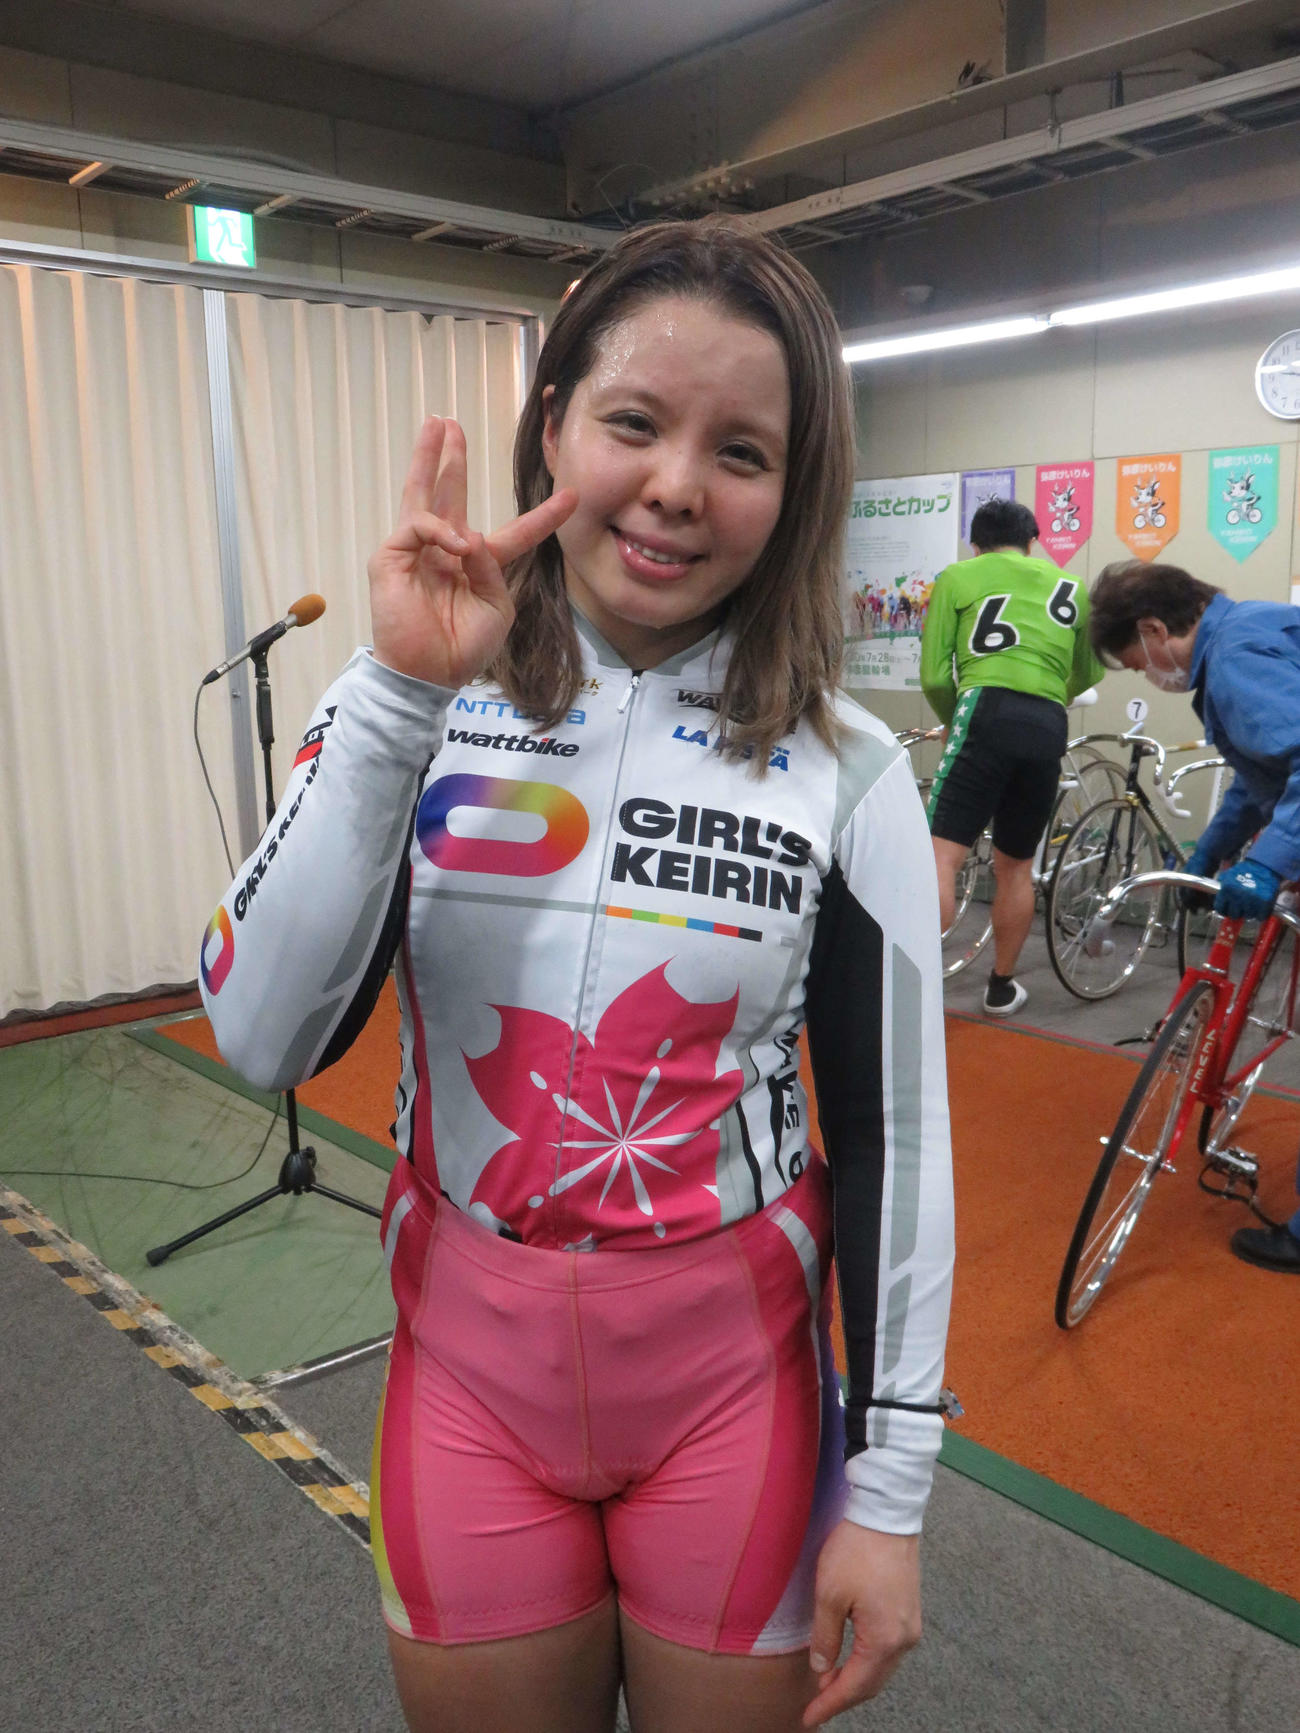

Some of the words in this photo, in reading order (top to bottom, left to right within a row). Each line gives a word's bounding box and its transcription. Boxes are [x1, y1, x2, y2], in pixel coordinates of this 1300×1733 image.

[968, 594, 1020, 656] 6
[1047, 577, 1079, 628] 6
[1133, 701, 1142, 719] 7
[447, 728, 580, 758] wattbike
[619, 797, 812, 866] GIRL'S
[610, 842, 803, 915] KEIRIN
[1189, 1028, 1216, 1094] LEVEL
